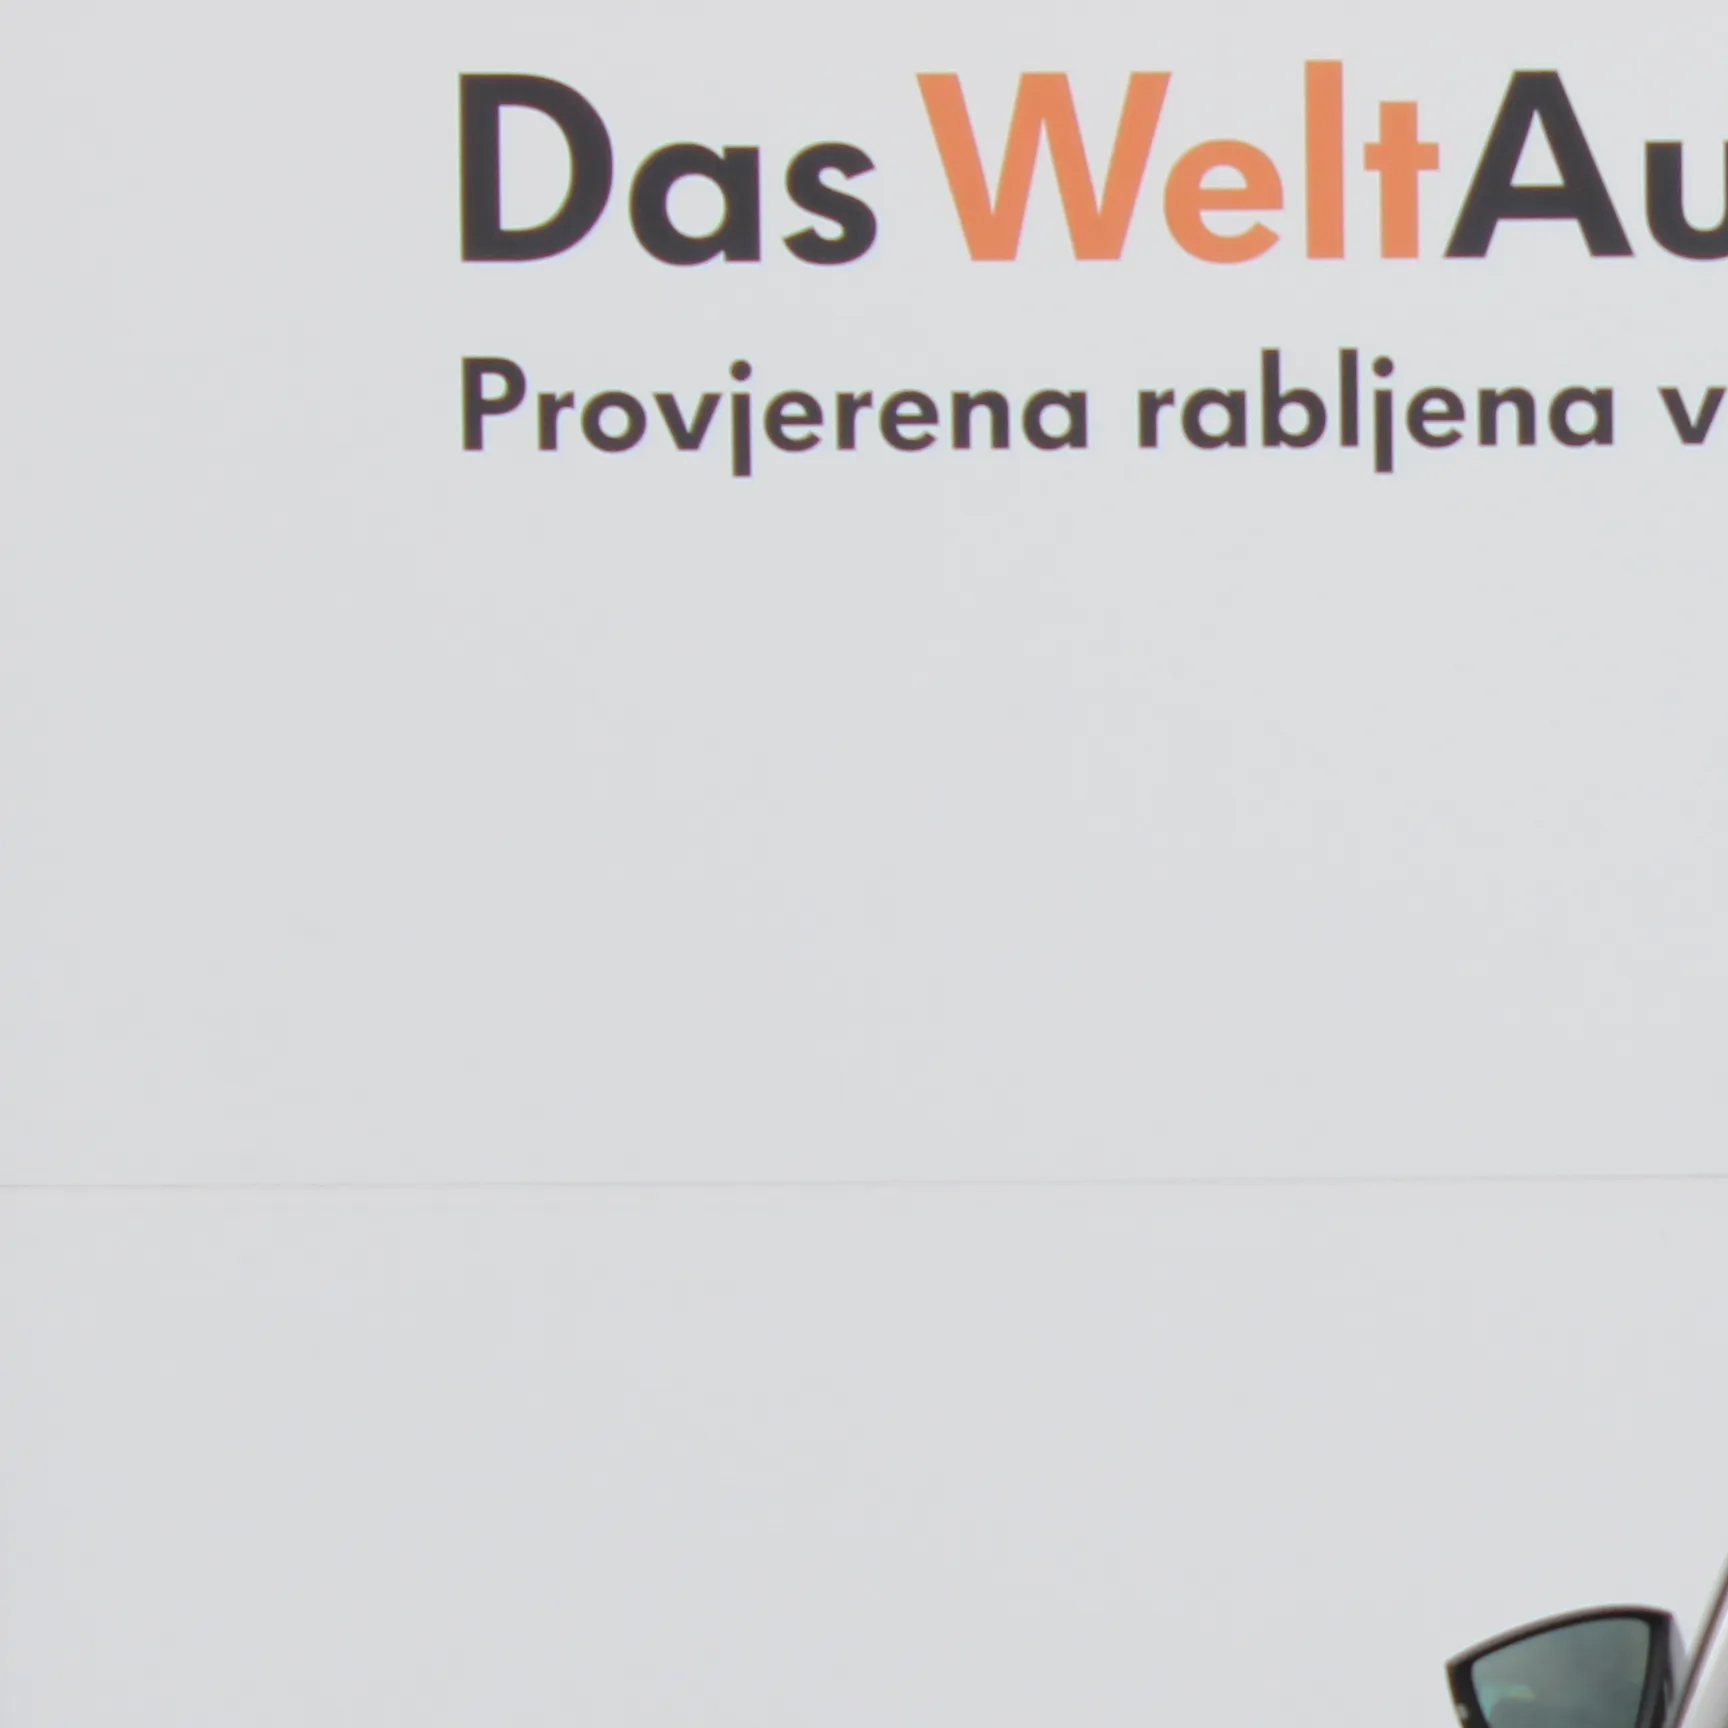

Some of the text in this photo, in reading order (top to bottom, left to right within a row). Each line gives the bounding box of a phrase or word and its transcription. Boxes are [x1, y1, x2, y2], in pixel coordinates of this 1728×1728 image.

[460, 74, 876, 265] Das
[463, 357, 1087, 476] Provjerena
[1139, 349, 1613, 472] rabljena
